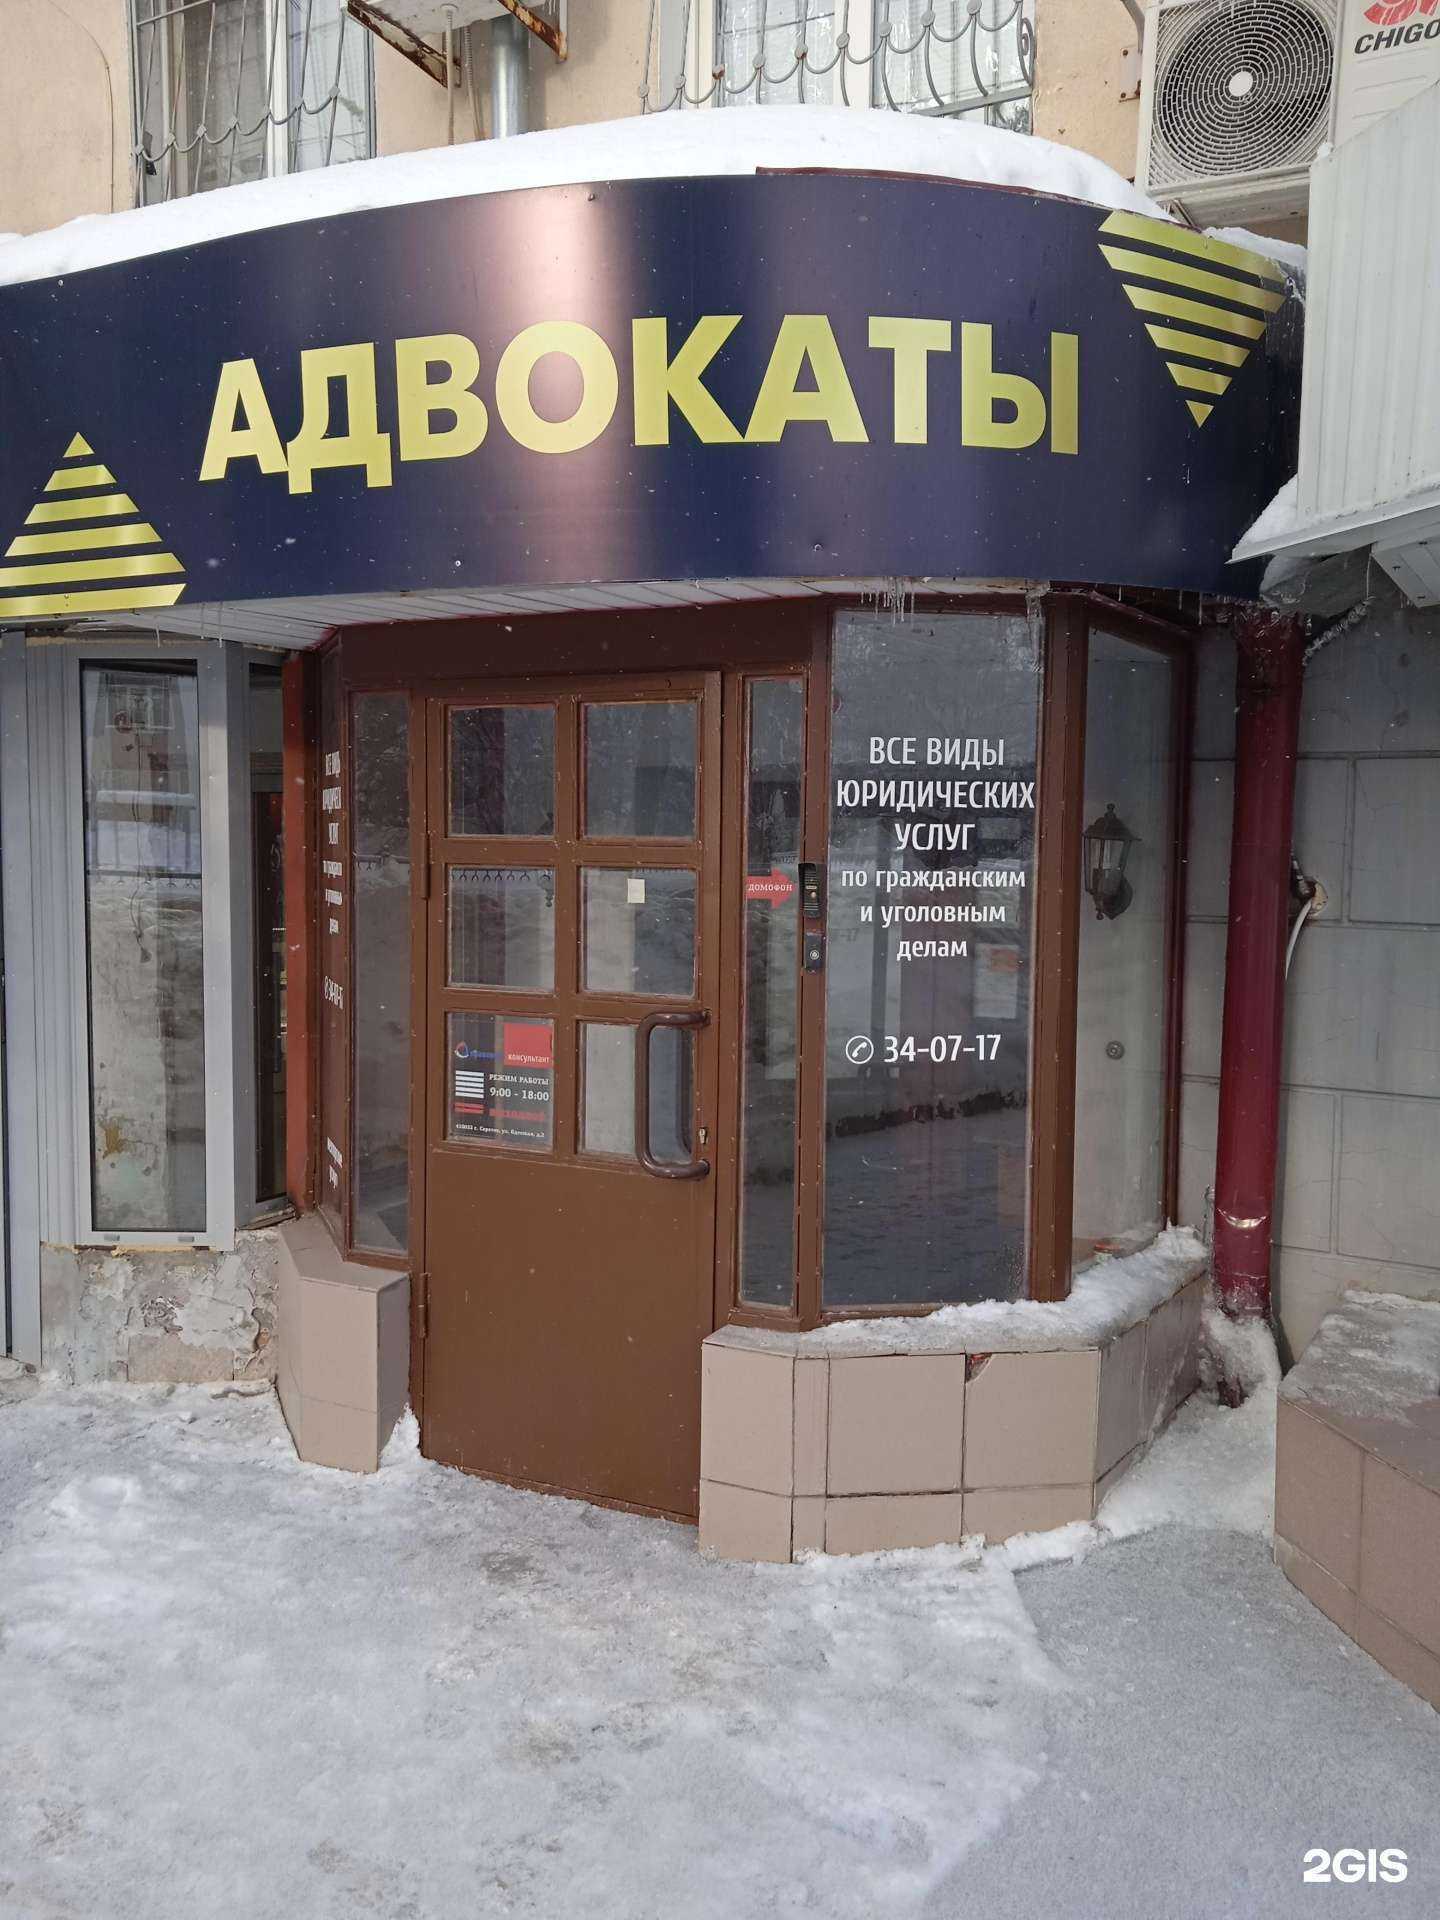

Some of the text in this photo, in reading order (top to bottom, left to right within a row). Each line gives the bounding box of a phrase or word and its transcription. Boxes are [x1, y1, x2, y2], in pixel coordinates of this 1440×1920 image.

[1354, 19, 1440, 54] CHIGO
[199, 314, 1080, 494] АДВОКАТЫ
[869, 737, 1005, 770] ВСЕ ВИДЫ
[836, 780, 1036, 812] ЮРИДИЧЕСКИХ
[895, 823, 976, 851] УСЛУГ
[748, 884, 793, 893] ДОМОФОН
[841, 869, 1026, 892] по гражданским
[860, 904, 1006, 926] и уголовным
[896, 939, 968, 960] делам
[884, 1034, 1001, 1064] 34-07-17
[489, 1073, 549, 1086] РЕЖИМ РАБОТЫ
[489, 1086, 512, 1097] 9:00
[522, 1090, 550, 1101] 18:00
